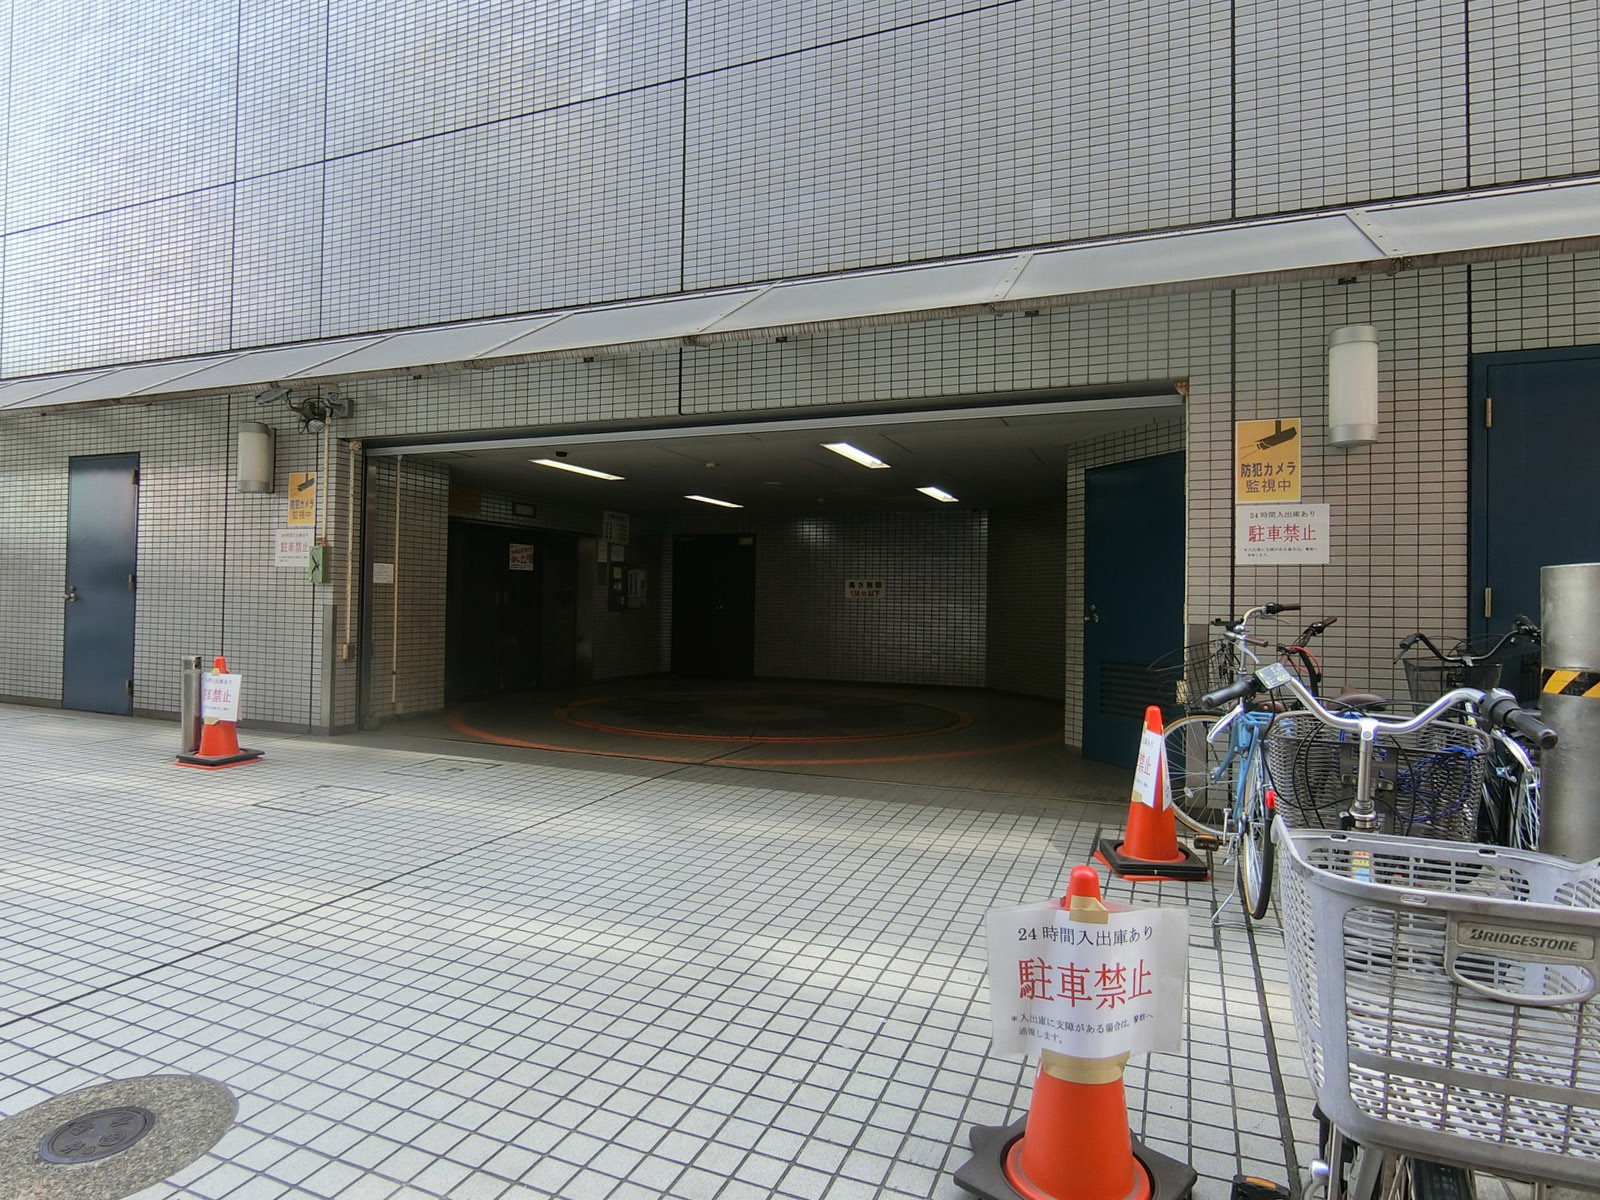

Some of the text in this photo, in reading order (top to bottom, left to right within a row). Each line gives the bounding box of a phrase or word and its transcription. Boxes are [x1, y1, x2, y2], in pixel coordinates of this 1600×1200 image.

[1241, 462, 1296, 478] 防犯カメラ
[1246, 478, 1291, 493] 監視中
[1248, 524, 1317, 543] 駐車禁止
[280, 541, 309, 553] 駐車禁止
[1469, 928, 1579, 952] BRIDGESTONE
[1017, 957, 1153, 1010] 駐車禁止
